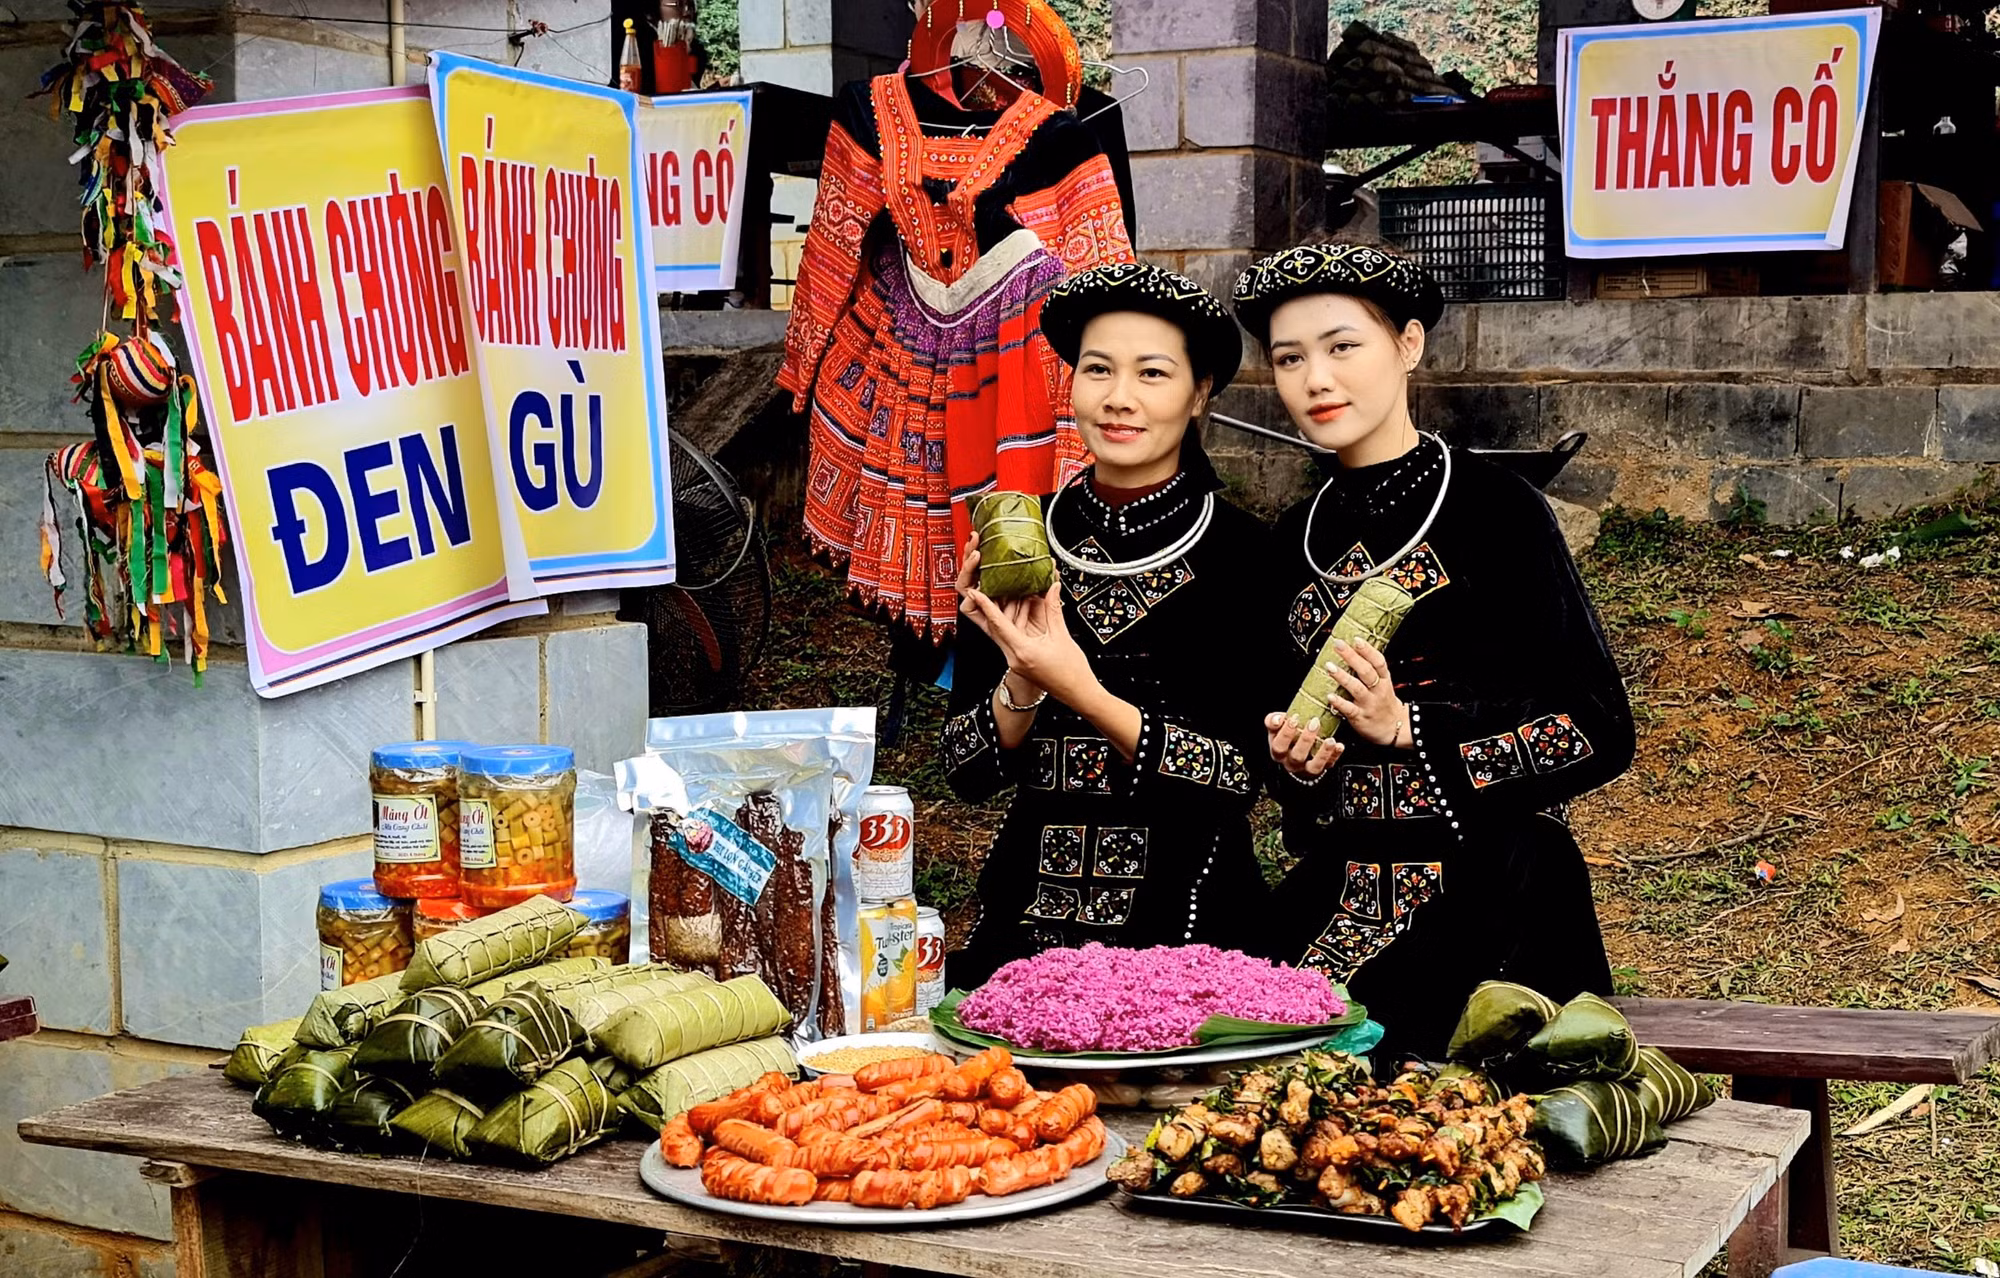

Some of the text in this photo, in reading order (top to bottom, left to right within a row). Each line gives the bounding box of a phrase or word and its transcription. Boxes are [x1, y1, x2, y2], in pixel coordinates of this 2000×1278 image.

[643, 119, 735, 227] NG CỐ
[1591, 47, 1844, 190] THẮNG CỐ
[196, 169, 470, 423] BÁNH CHƯNG
[461, 117, 626, 352] BÁNH CHƯNG
[509, 360, 601, 511] GÙ
[267, 424, 472, 595] ĐEN
[862, 810, 905, 847] 333
[917, 933, 941, 968] 33
